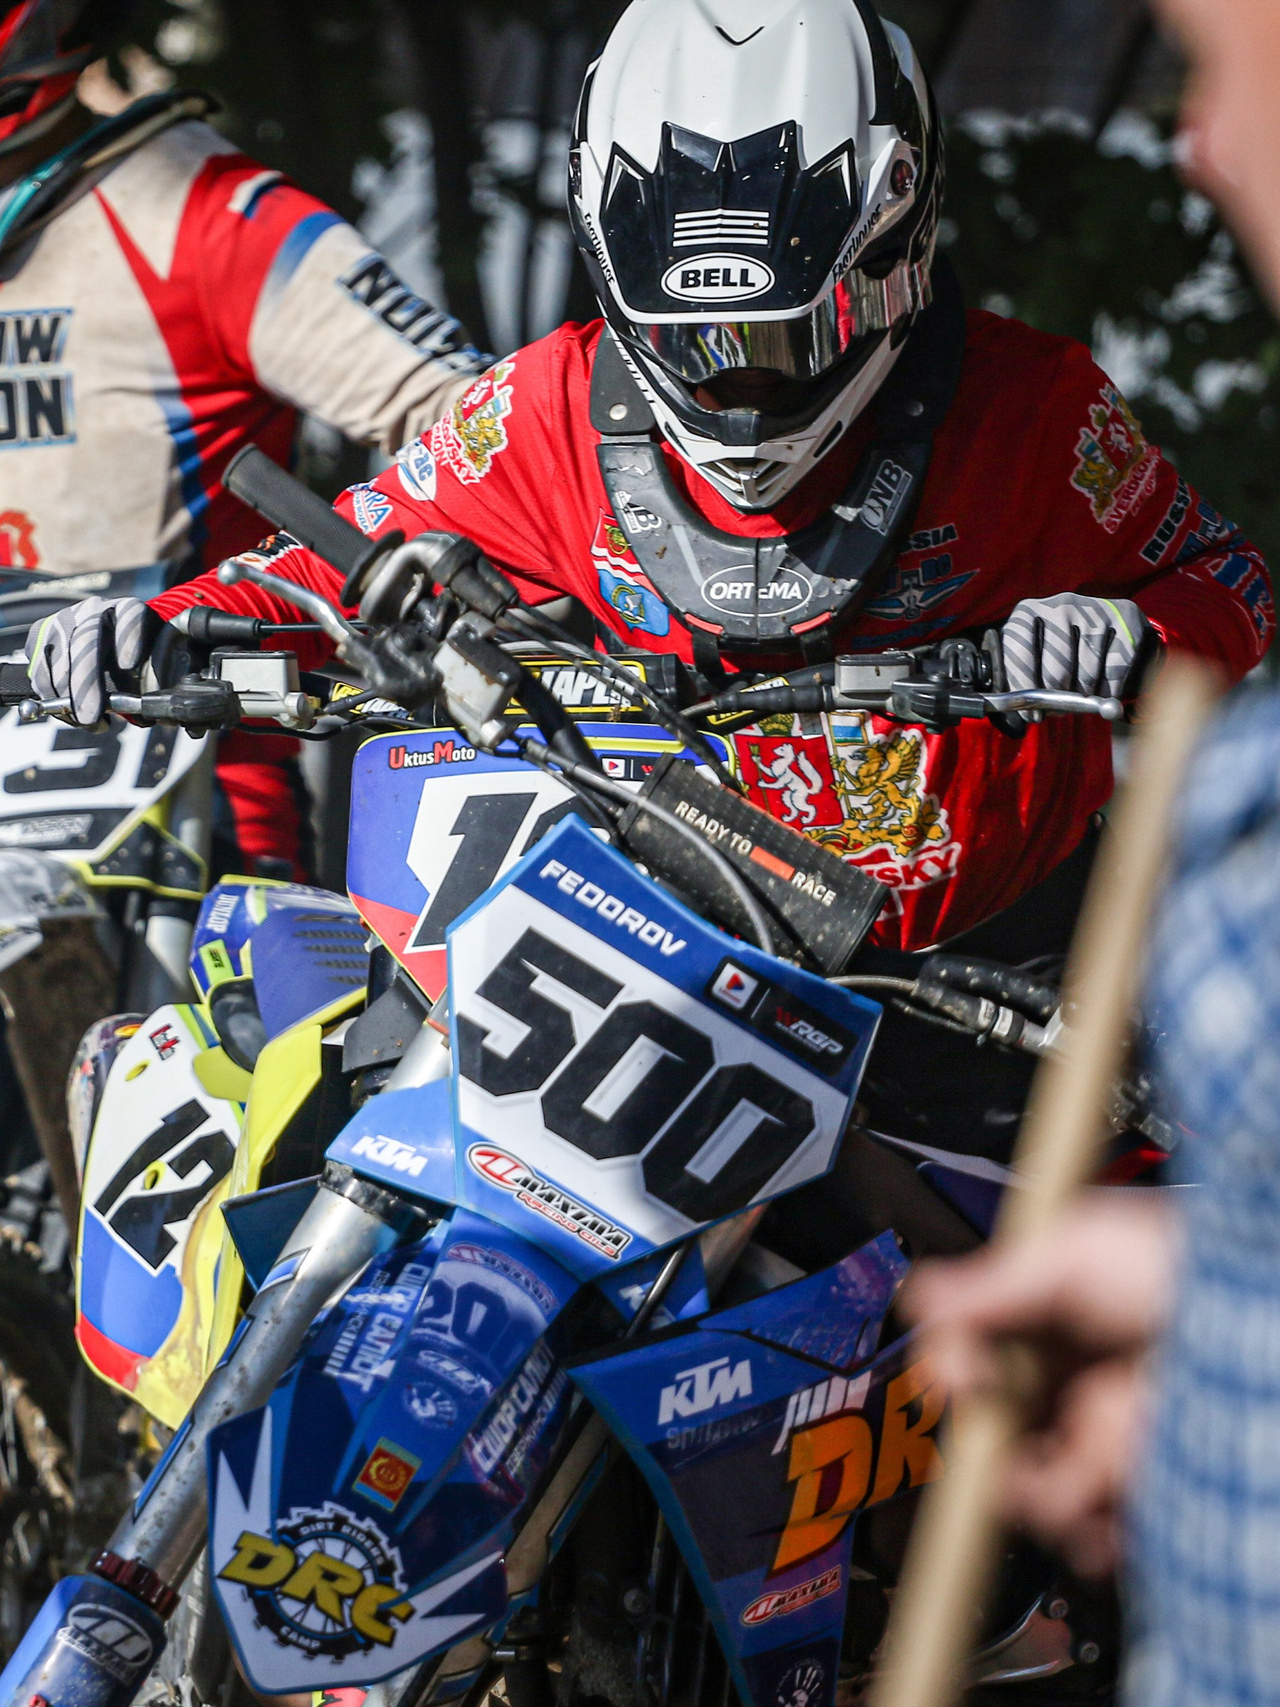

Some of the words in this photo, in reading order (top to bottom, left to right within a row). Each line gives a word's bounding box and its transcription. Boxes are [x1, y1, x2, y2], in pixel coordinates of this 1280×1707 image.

[680, 268, 756, 289] BELL
[709, 581, 803, 600] ORTEMA
[388, 740, 477, 770] UktusMoto
[674, 800, 730, 841] READY
[730, 832, 753, 855] TO
[791, 871, 837, 907] RACE
[206, 893, 240, 934] DUNLOP
[538, 858, 688, 957] FEDOROV
[457, 927, 816, 1225] 500
[94, 1098, 236, 1270] 12
[350, 1134, 428, 1179] KTM
[512, 1175, 630, 1248] MAXIMA
[519, 1190, 579, 1232] RACING
[579, 1229, 617, 1257] OILS
[658, 1356, 753, 1426] KTM
[299, 1521, 335, 1535] DIRT
[339, 1522, 386, 1565] RIDERS
[217, 1530, 416, 1648] DRC
[279, 1624, 321, 1649] CAMP
